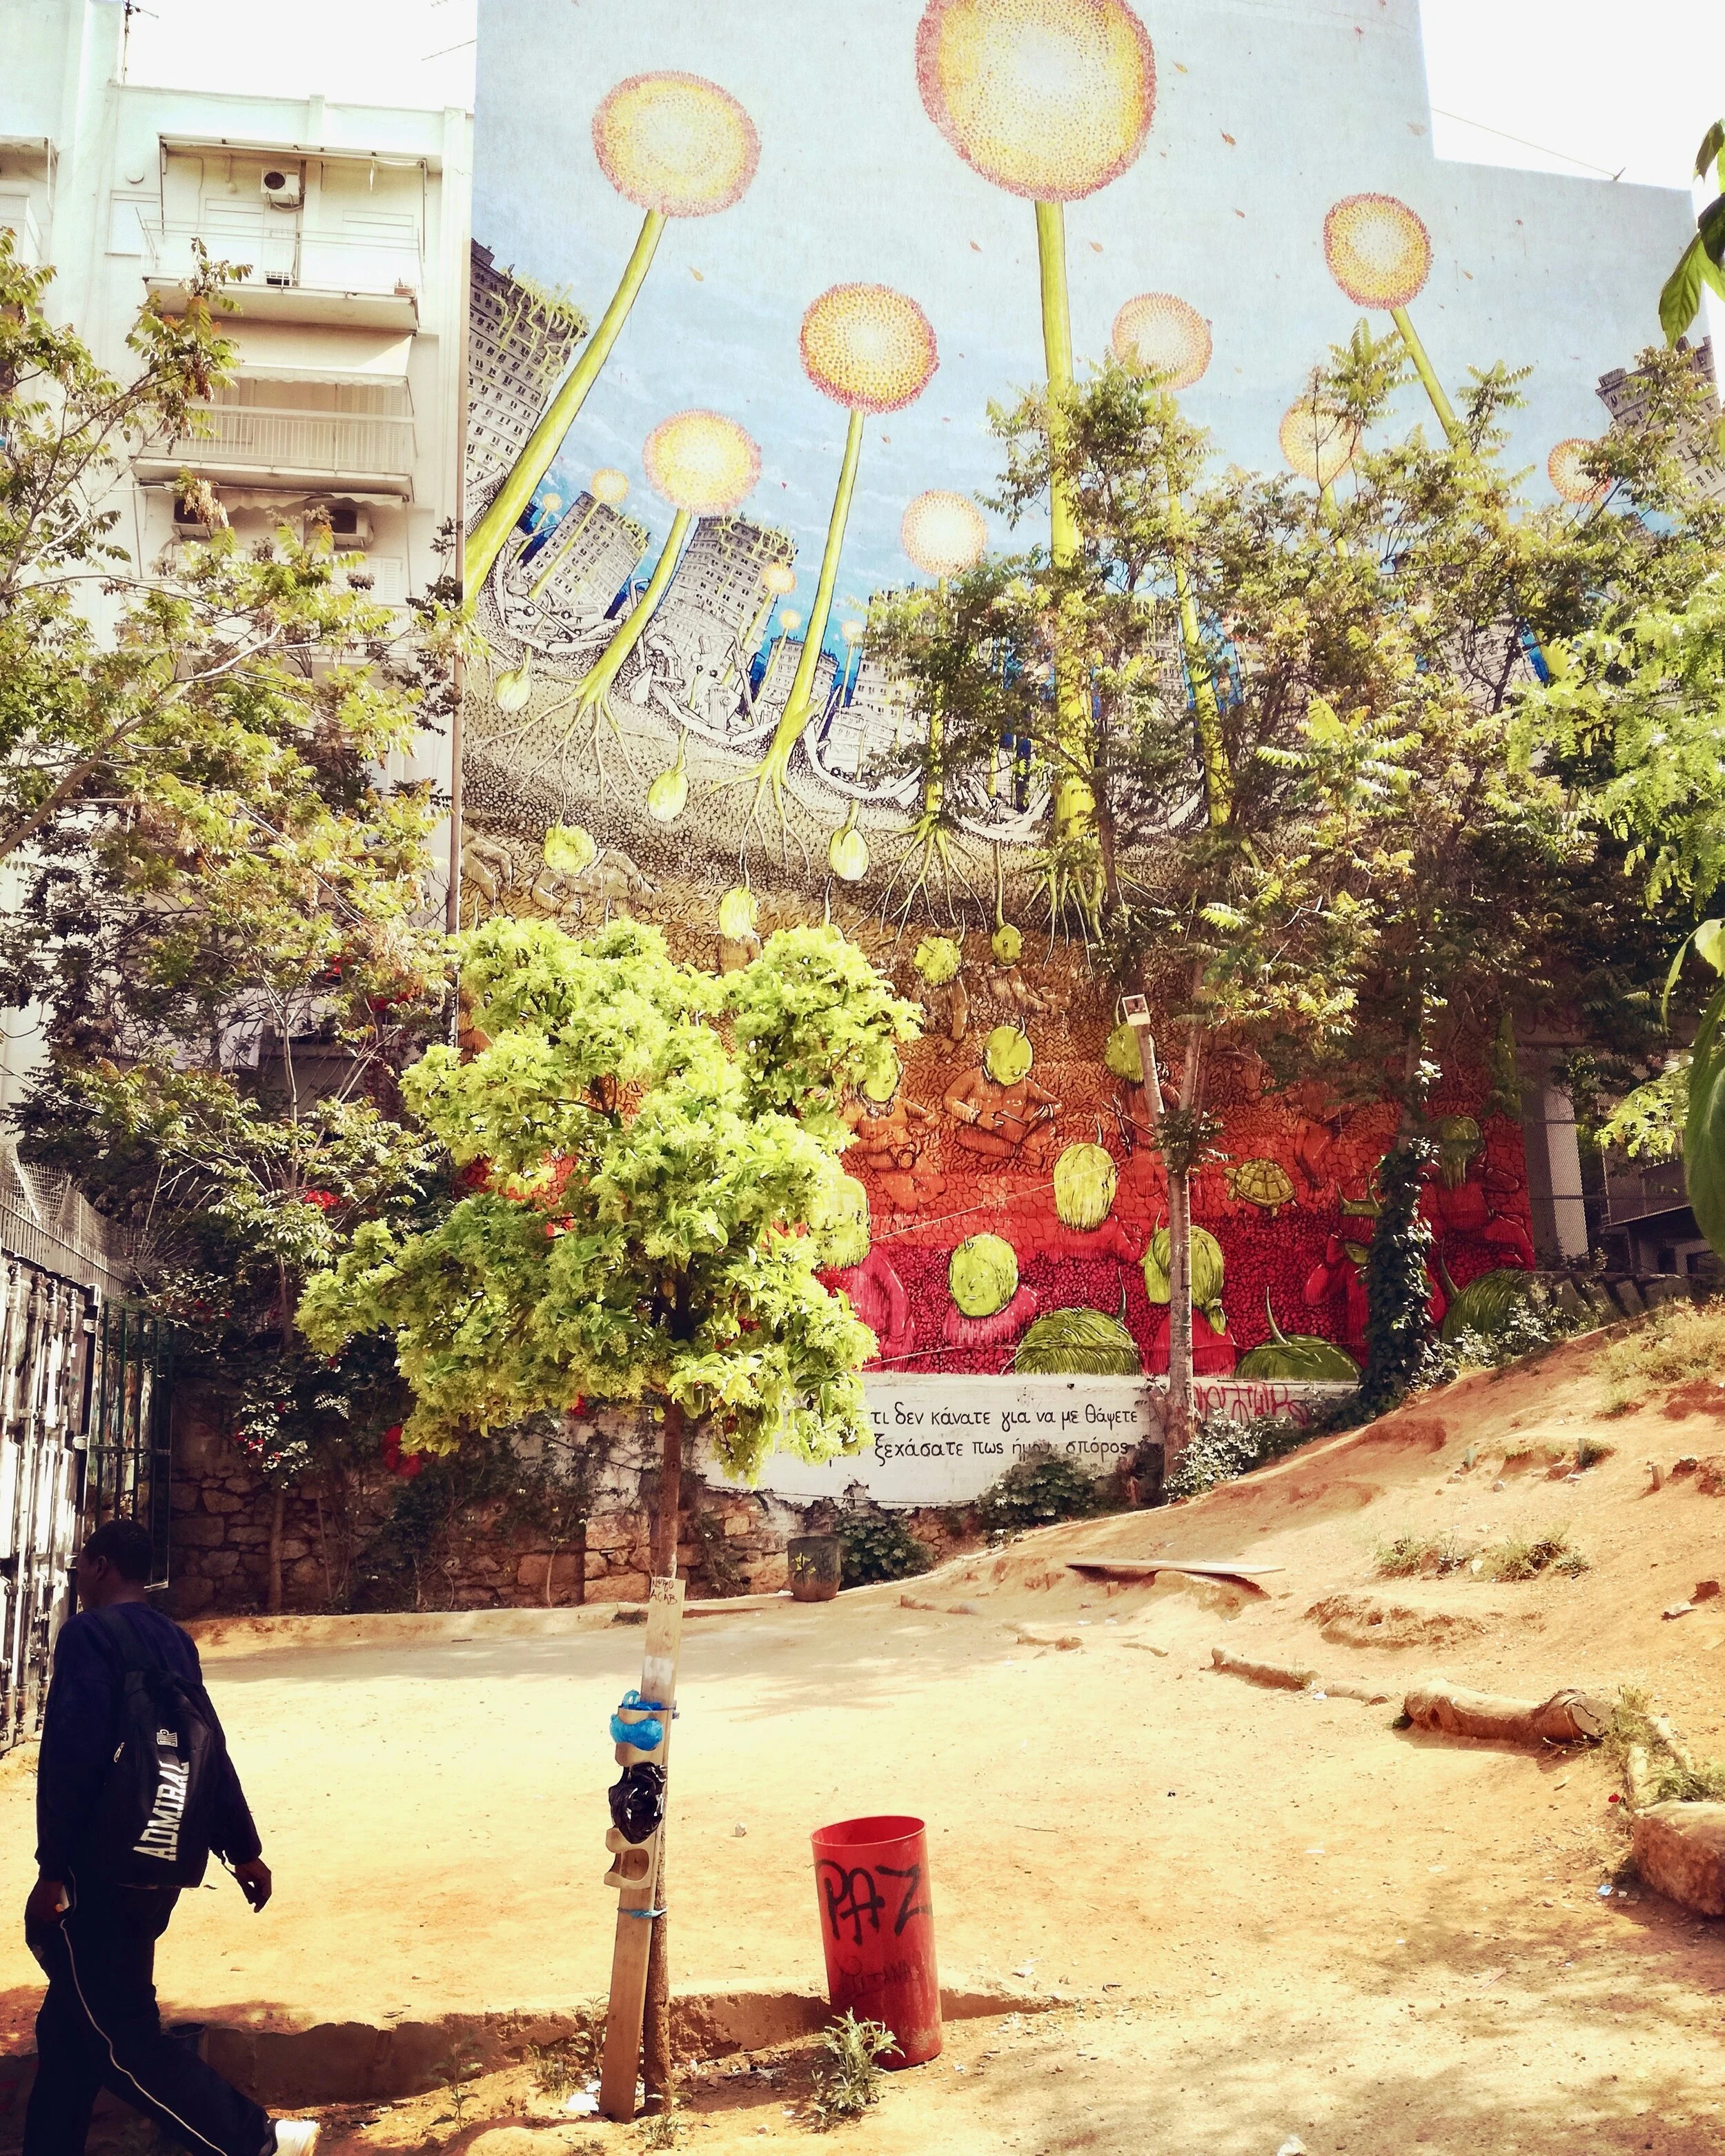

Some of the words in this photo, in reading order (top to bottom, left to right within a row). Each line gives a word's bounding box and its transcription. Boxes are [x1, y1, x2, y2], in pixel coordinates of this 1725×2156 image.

[870, 1412, 889, 1425] τι
[894, 1401, 924, 1425] δεν
[931, 1407, 991, 1425] κάνατε
[1001, 1411, 1031, 1432] για
[1036, 1412, 1056, 1424] να
[1062, 1410, 1079, 1431] με
[1085, 1404, 1138, 1431] θάψετε
[874, 1433, 963, 1467] ξεχάσατε
[972, 1441, 1004, 1454] πως
[1066, 1436, 1128, 1463] σπόρος
[132, 1761, 190, 1862] ADMIRAL
[816, 1859, 932, 1946] PAZ
